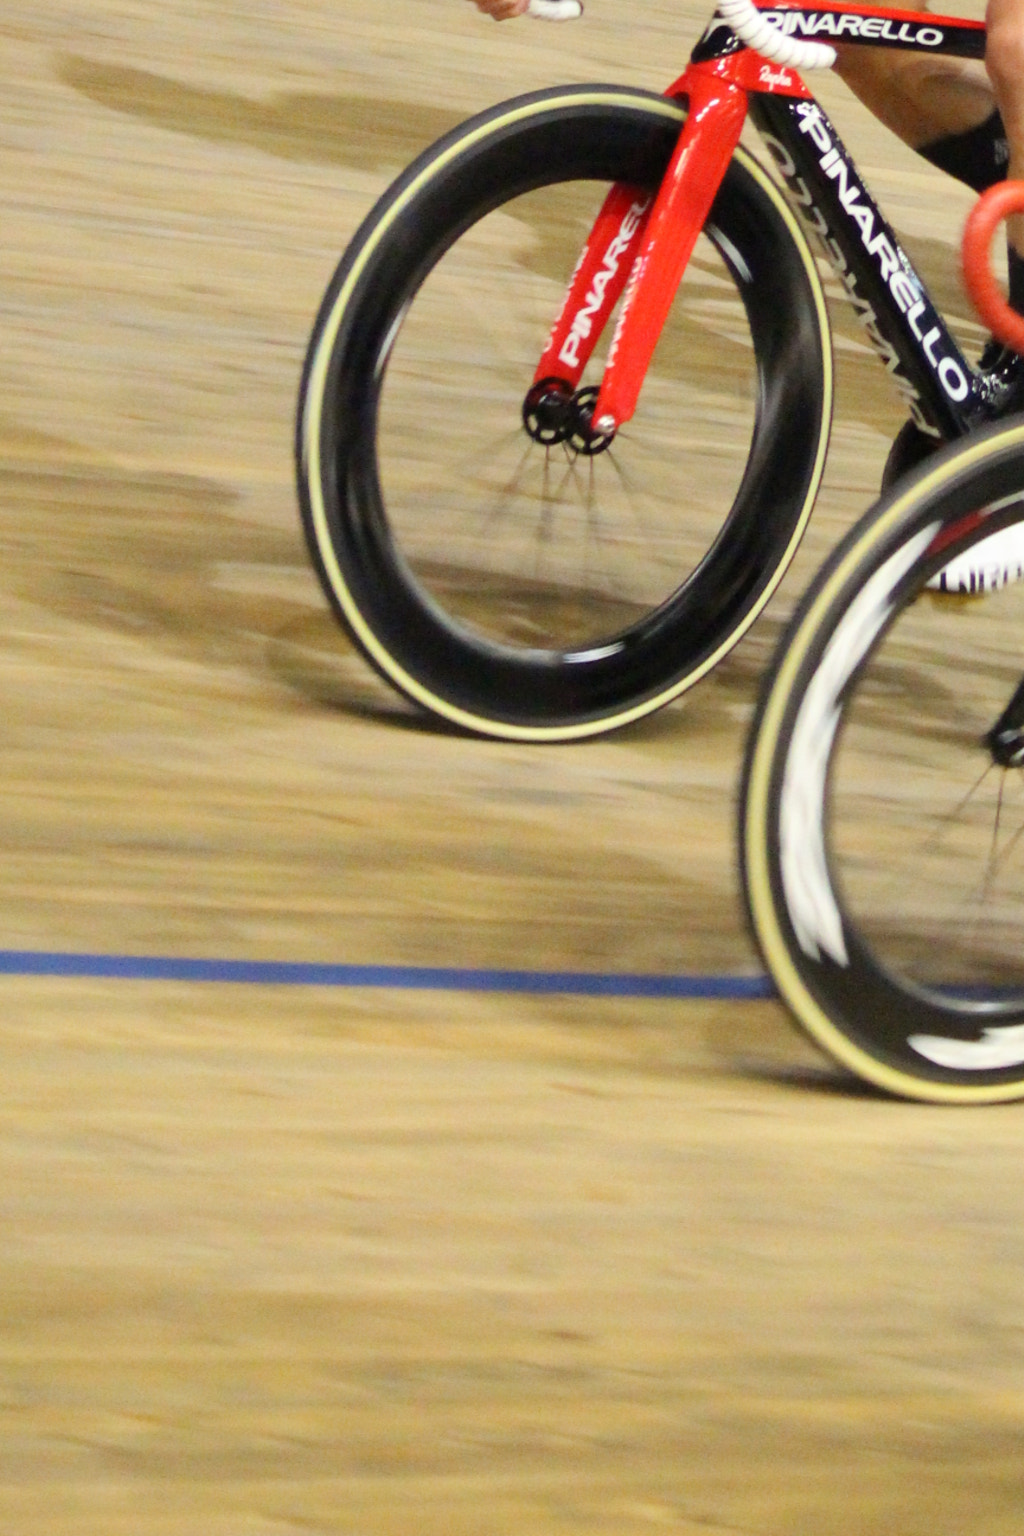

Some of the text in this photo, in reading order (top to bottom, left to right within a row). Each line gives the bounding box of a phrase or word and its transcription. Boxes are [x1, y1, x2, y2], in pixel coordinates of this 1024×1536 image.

[759, 65, 793, 91] Rapha
[763, 11, 944, 46] PINARELLO
[558, 198, 649, 368] PINAREL
[799, 112, 969, 403] PINARELLO
